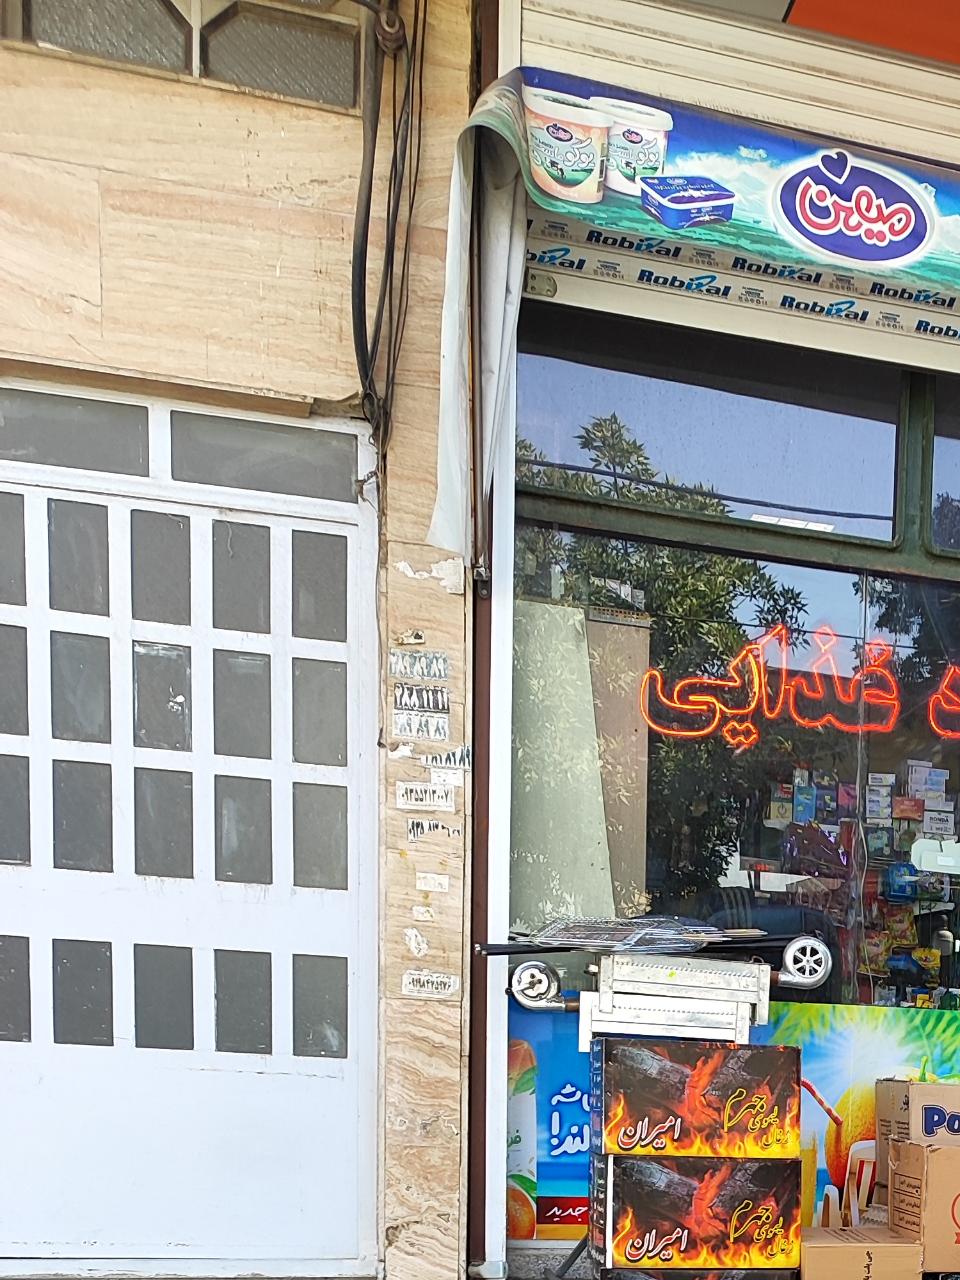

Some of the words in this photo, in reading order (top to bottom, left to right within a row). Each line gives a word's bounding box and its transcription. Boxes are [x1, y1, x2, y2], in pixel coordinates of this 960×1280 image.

[802, 176, 914, 245] میهن
[638, 624, 900, 750] غذایی
[617, 1110, 682, 1151] امیران
[625, 1227, 689, 1261] امیران
